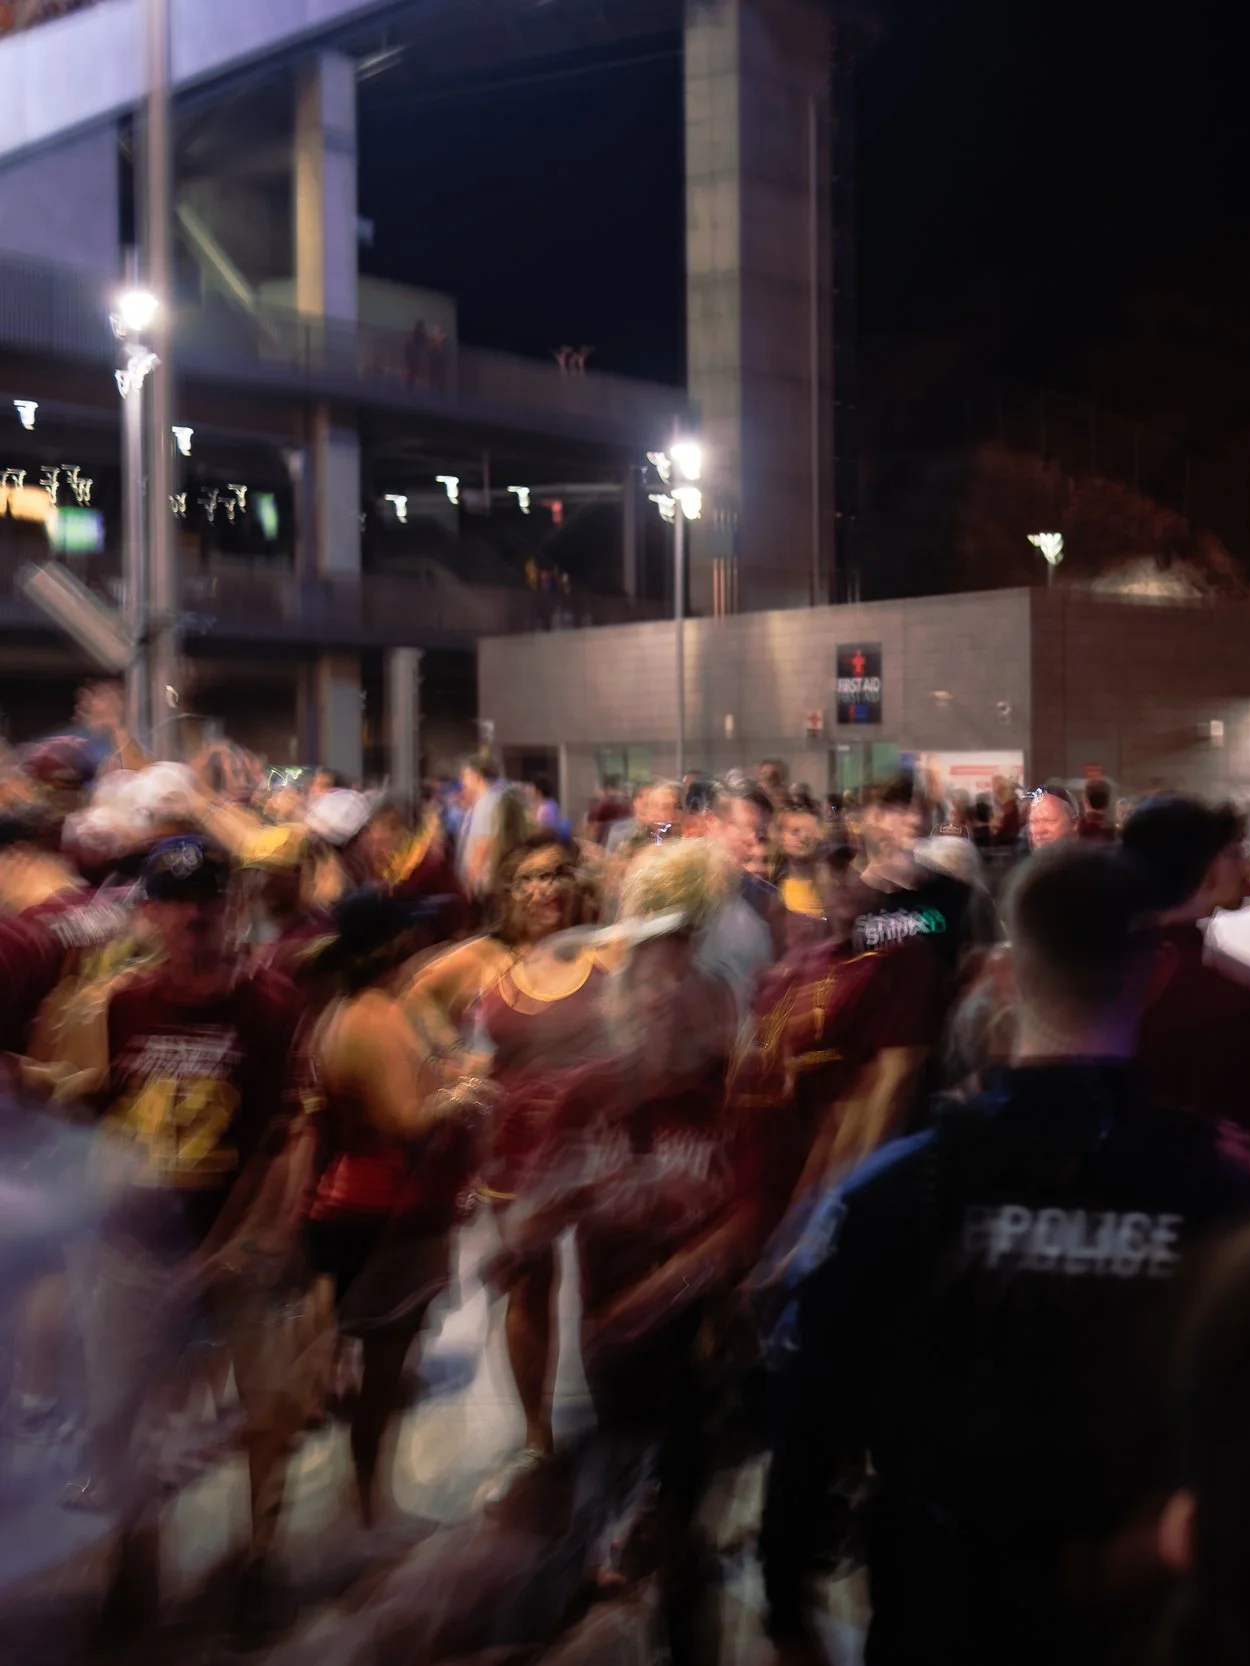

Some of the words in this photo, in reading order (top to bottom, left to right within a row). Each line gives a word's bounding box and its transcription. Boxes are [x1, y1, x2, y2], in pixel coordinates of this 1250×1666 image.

[838, 677, 862, 693] FIRST
[863, 676, 881, 692] AID
[980, 1203, 1185, 1277] POLICE
